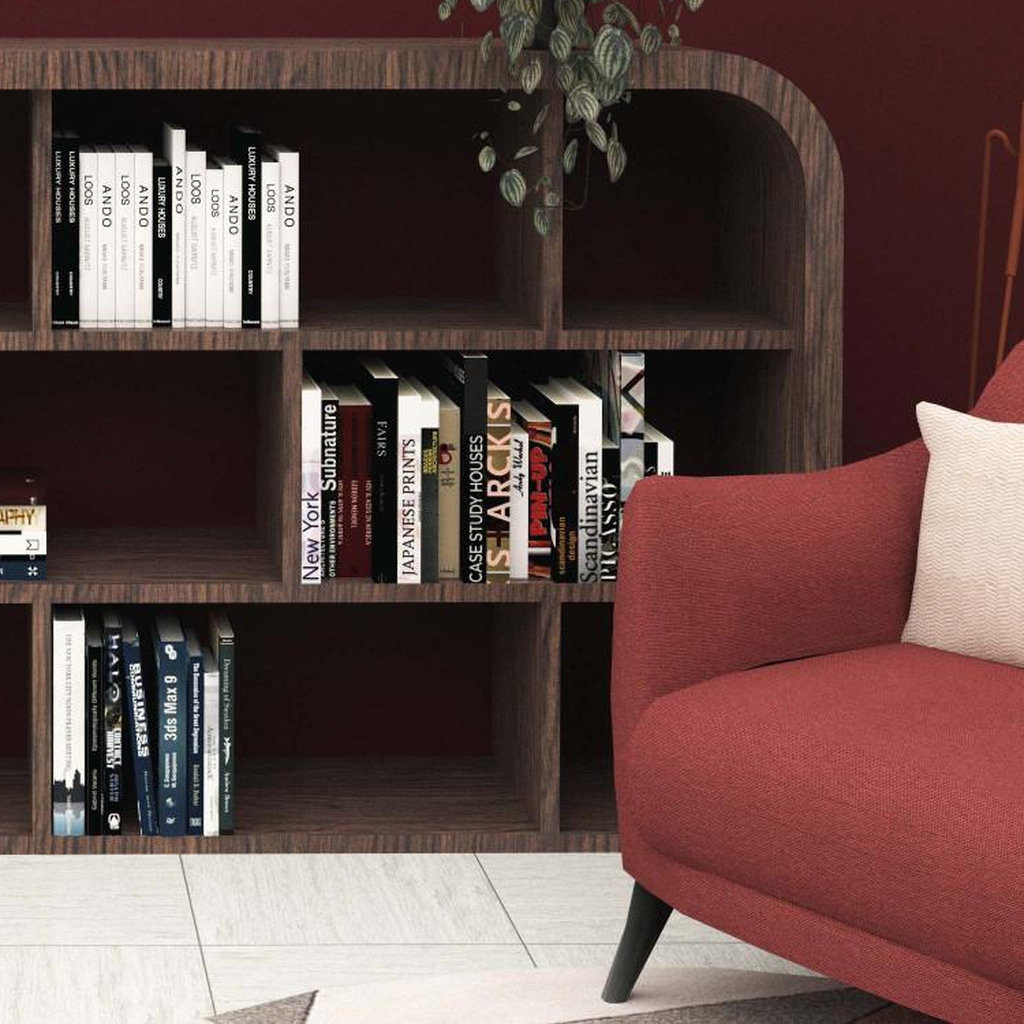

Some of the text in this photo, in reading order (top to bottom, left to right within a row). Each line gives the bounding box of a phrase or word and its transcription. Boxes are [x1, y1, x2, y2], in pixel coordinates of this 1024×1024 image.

[84, 175, 94, 206] LOOS
[120, 175, 130, 206] LOOS
[175, 166, 184, 215] ANDO
[190, 173, 202, 205] LOOS
[211, 189, 220, 218] LOOS
[248, 146, 256, 221] LUXURY HOUSES
[266, 183, 276, 213] LOOS
[102, 185, 112, 228] ANDO
[139, 184, 149, 228] ANDO
[157, 177, 166, 239] LUXURY HOUSES
[228, 194, 239, 235] ANDO
[284, 184, 295, 228] ANDO
[320, 404, 337, 492] Subnature
[376, 420, 388, 457] FAIRS
[513, 439, 525, 497] Andy Warhol
[402, 439, 417, 576] JAPANESE PRINTS
[468, 435, 483, 582] CASE STUDY HOUSES
[530, 446, 548, 536] PIN-UP
[302, 492, 320, 580] New York
[579, 451, 598, 583] Scandinavian
[600, 482, 617, 581] PICASSO
[557, 516, 566, 575] scandinavian
[568, 530, 577, 561] design
[106, 634, 120, 701] HALO
[164, 675, 178, 684] 9
[133, 662, 150, 757] BUSINESS
[164, 687, 178, 714] Max
[114, 727, 122, 766] CONTACT
[164, 718, 178, 741] 3ds
